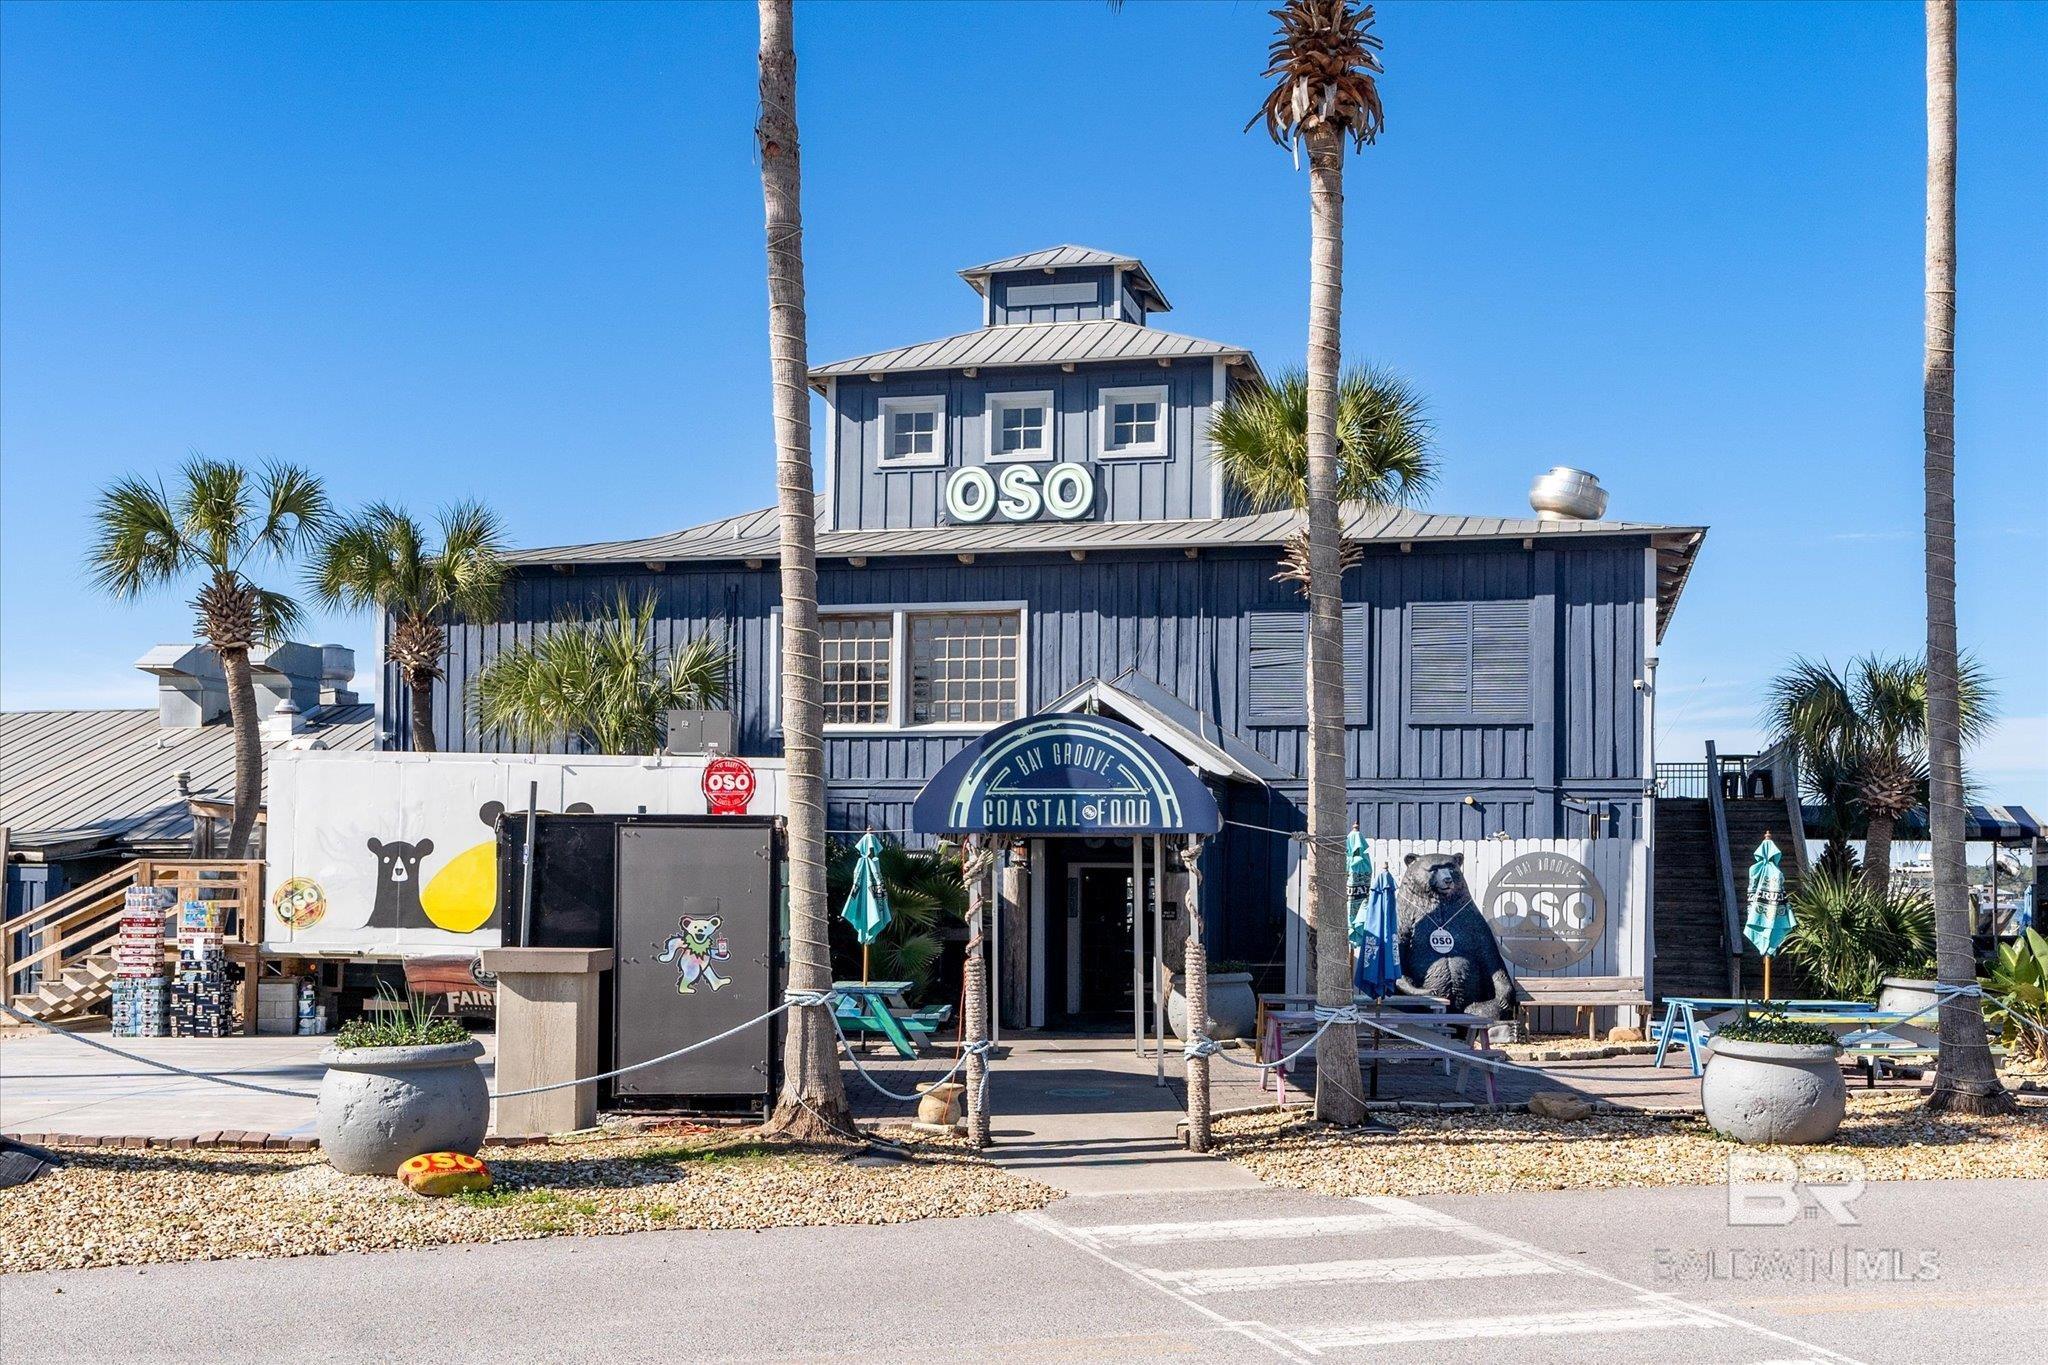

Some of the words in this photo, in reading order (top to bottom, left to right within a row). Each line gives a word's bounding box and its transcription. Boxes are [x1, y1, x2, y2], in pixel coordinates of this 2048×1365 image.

[945, 462, 1095, 522] OSO
[1015, 747, 1043, 776] BAY
[1053, 743, 1115, 776] GROOVE
[708, 774, 750, 790] OSO
[982, 799, 1080, 826] COASTAL
[1097, 799, 1151, 826] FOOD
[280, 887, 319, 918] OSO
[1493, 891, 1597, 930] OSO
[1432, 937, 1452, 945] OSO
[474, 968, 498, 979] OS
[402, 1152, 483, 1173] OSO
